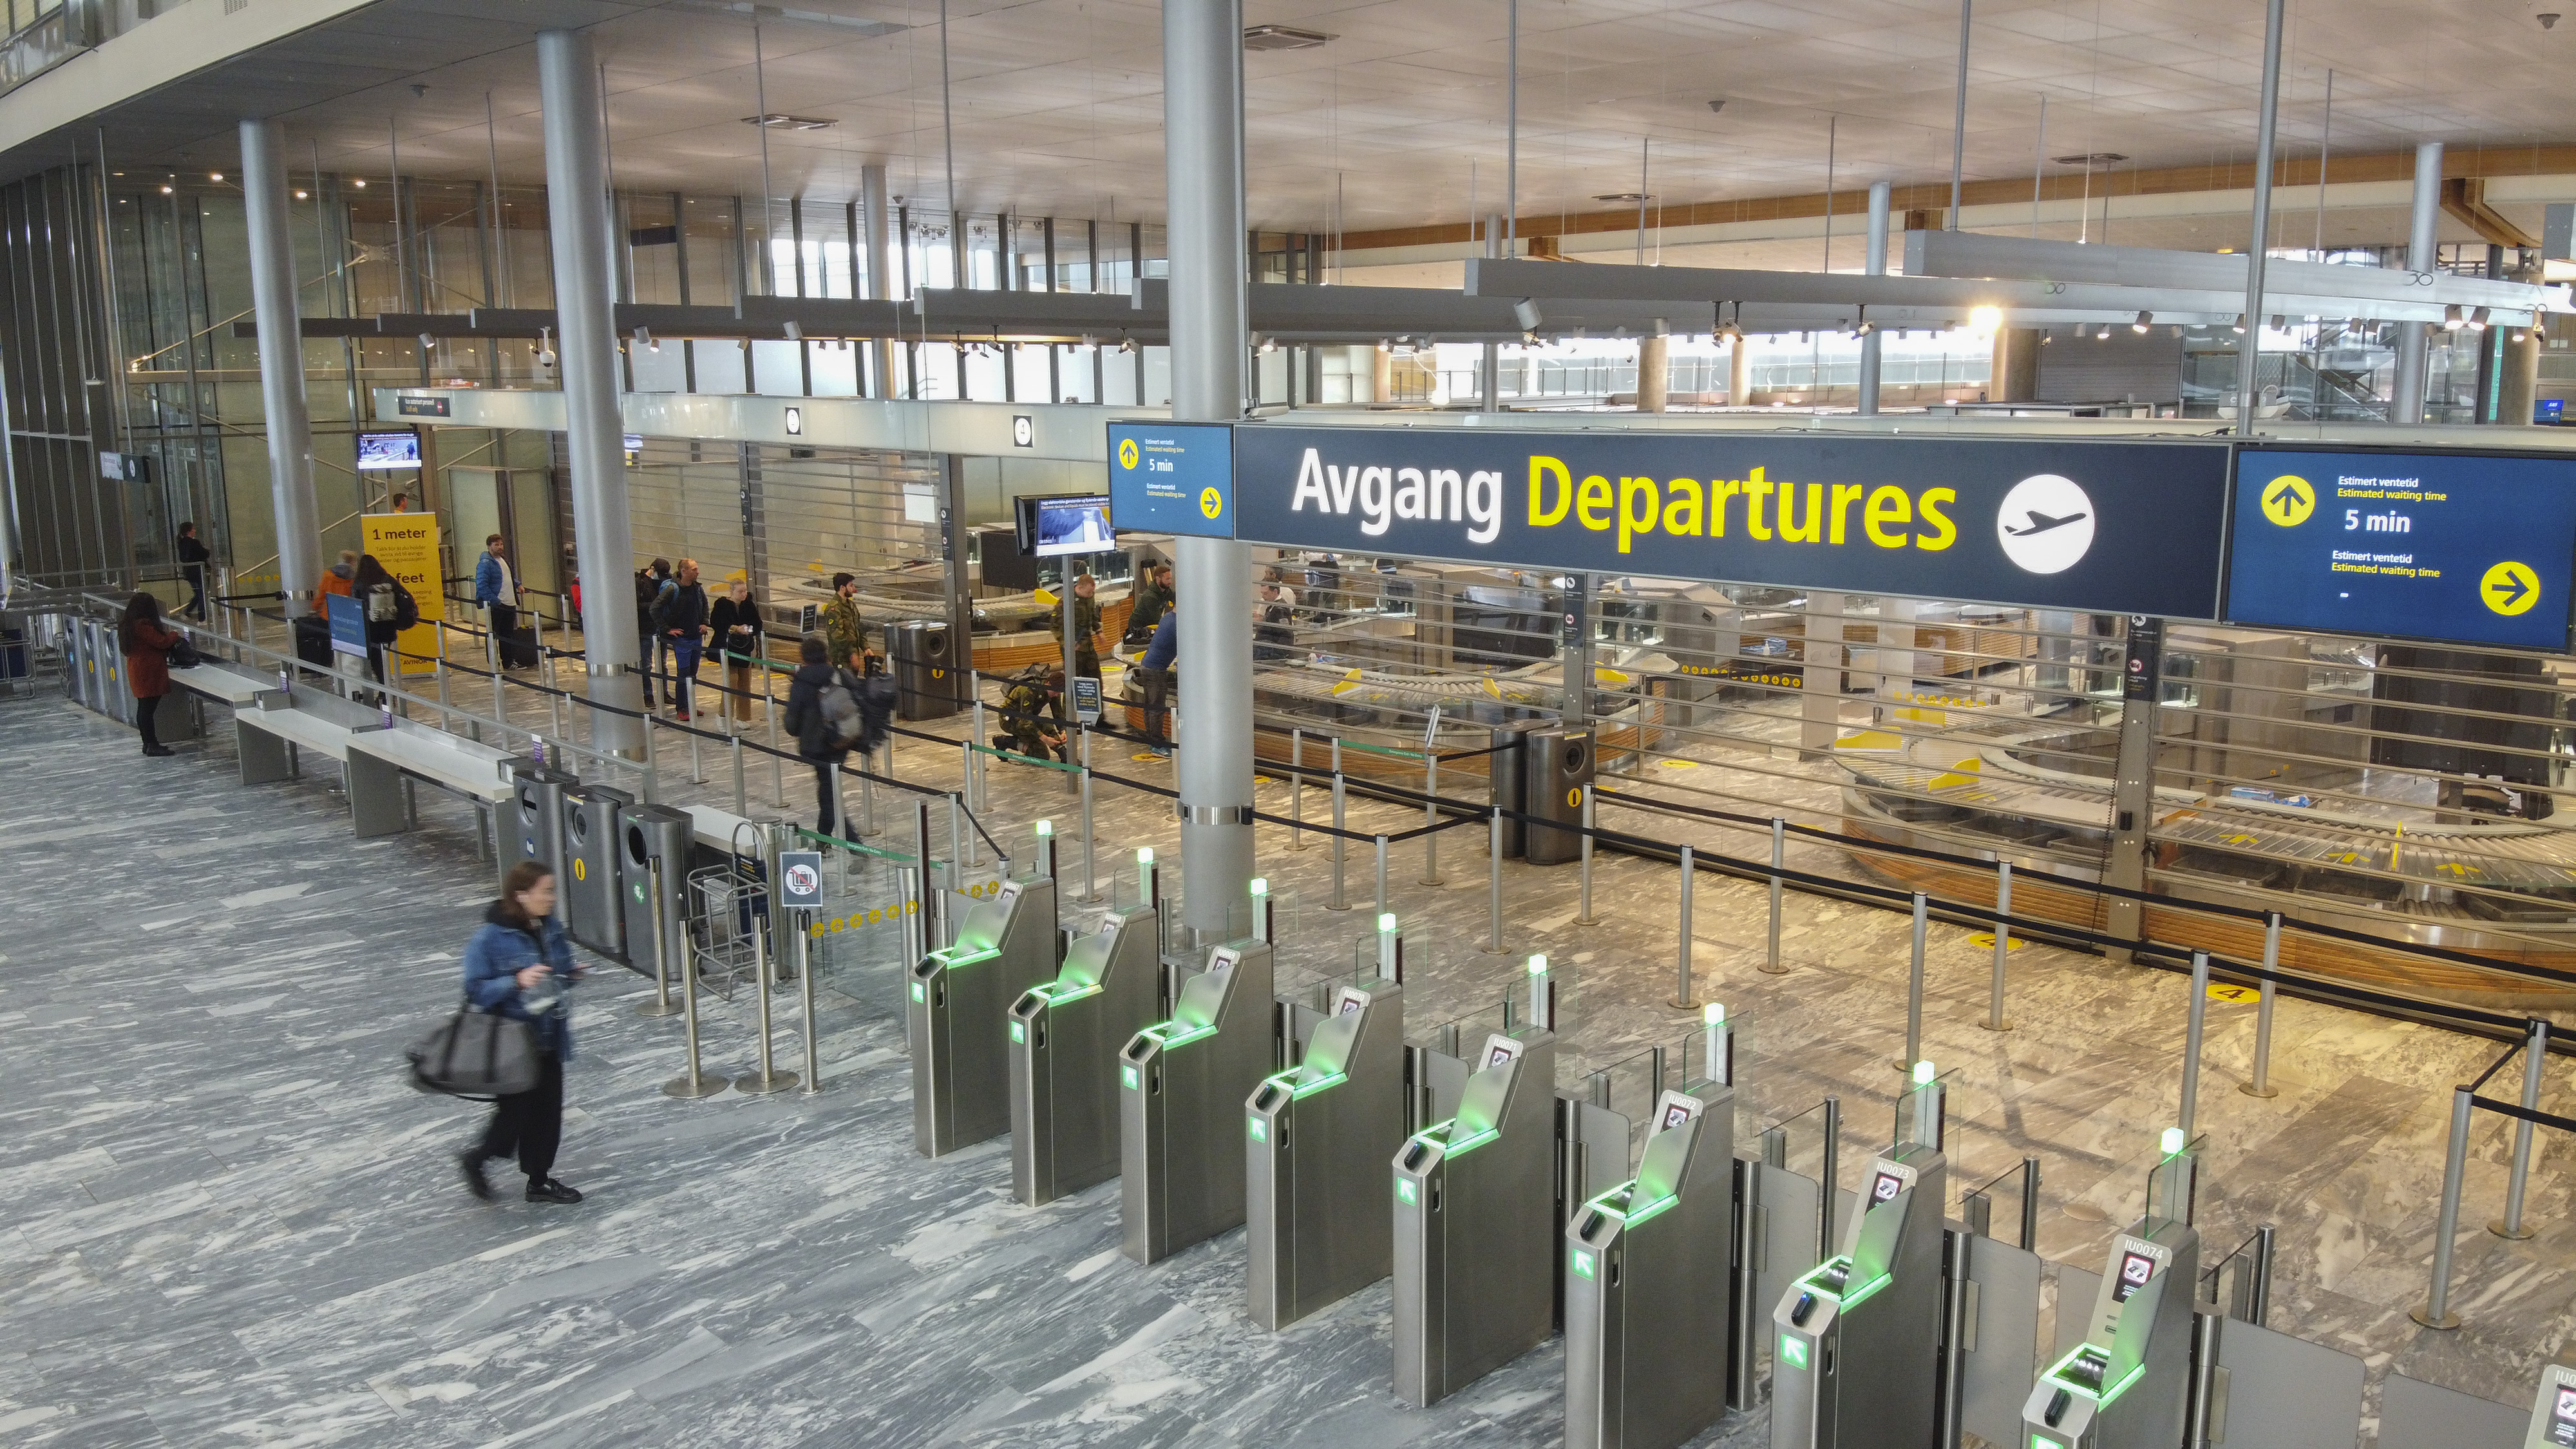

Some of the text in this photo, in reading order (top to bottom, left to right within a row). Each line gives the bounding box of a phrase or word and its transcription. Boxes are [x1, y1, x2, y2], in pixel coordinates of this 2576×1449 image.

[1150, 459, 1173, 471] 5 min
[2338, 476, 2418, 488] Estimert ventetid
[1292, 448, 1957, 554] Avgang Departures
[2338, 488, 2447, 502] Estimated waiting time
[2345, 509, 2410, 533] 5 min
[373, 528, 426, 540] 1 meter
[2332, 551, 2412, 563] Estimert ventetid
[2331, 562, 2441, 577] Estimated waiting time
[396, 573, 425, 583] feet
[1217, 948, 1236, 959] IU0069
[1344, 989, 1365, 1001] IU0070
[2216, 989, 2247, 999] 4
[1493, 1037, 1517, 1051] IU0071
[1668, 1094, 1696, 1110] IU0072
[1877, 1161, 1909, 1179] IU0073
[2125, 1239, 2163, 1260] IU0074
[2555, 1369, 2576, 1385] IU0
